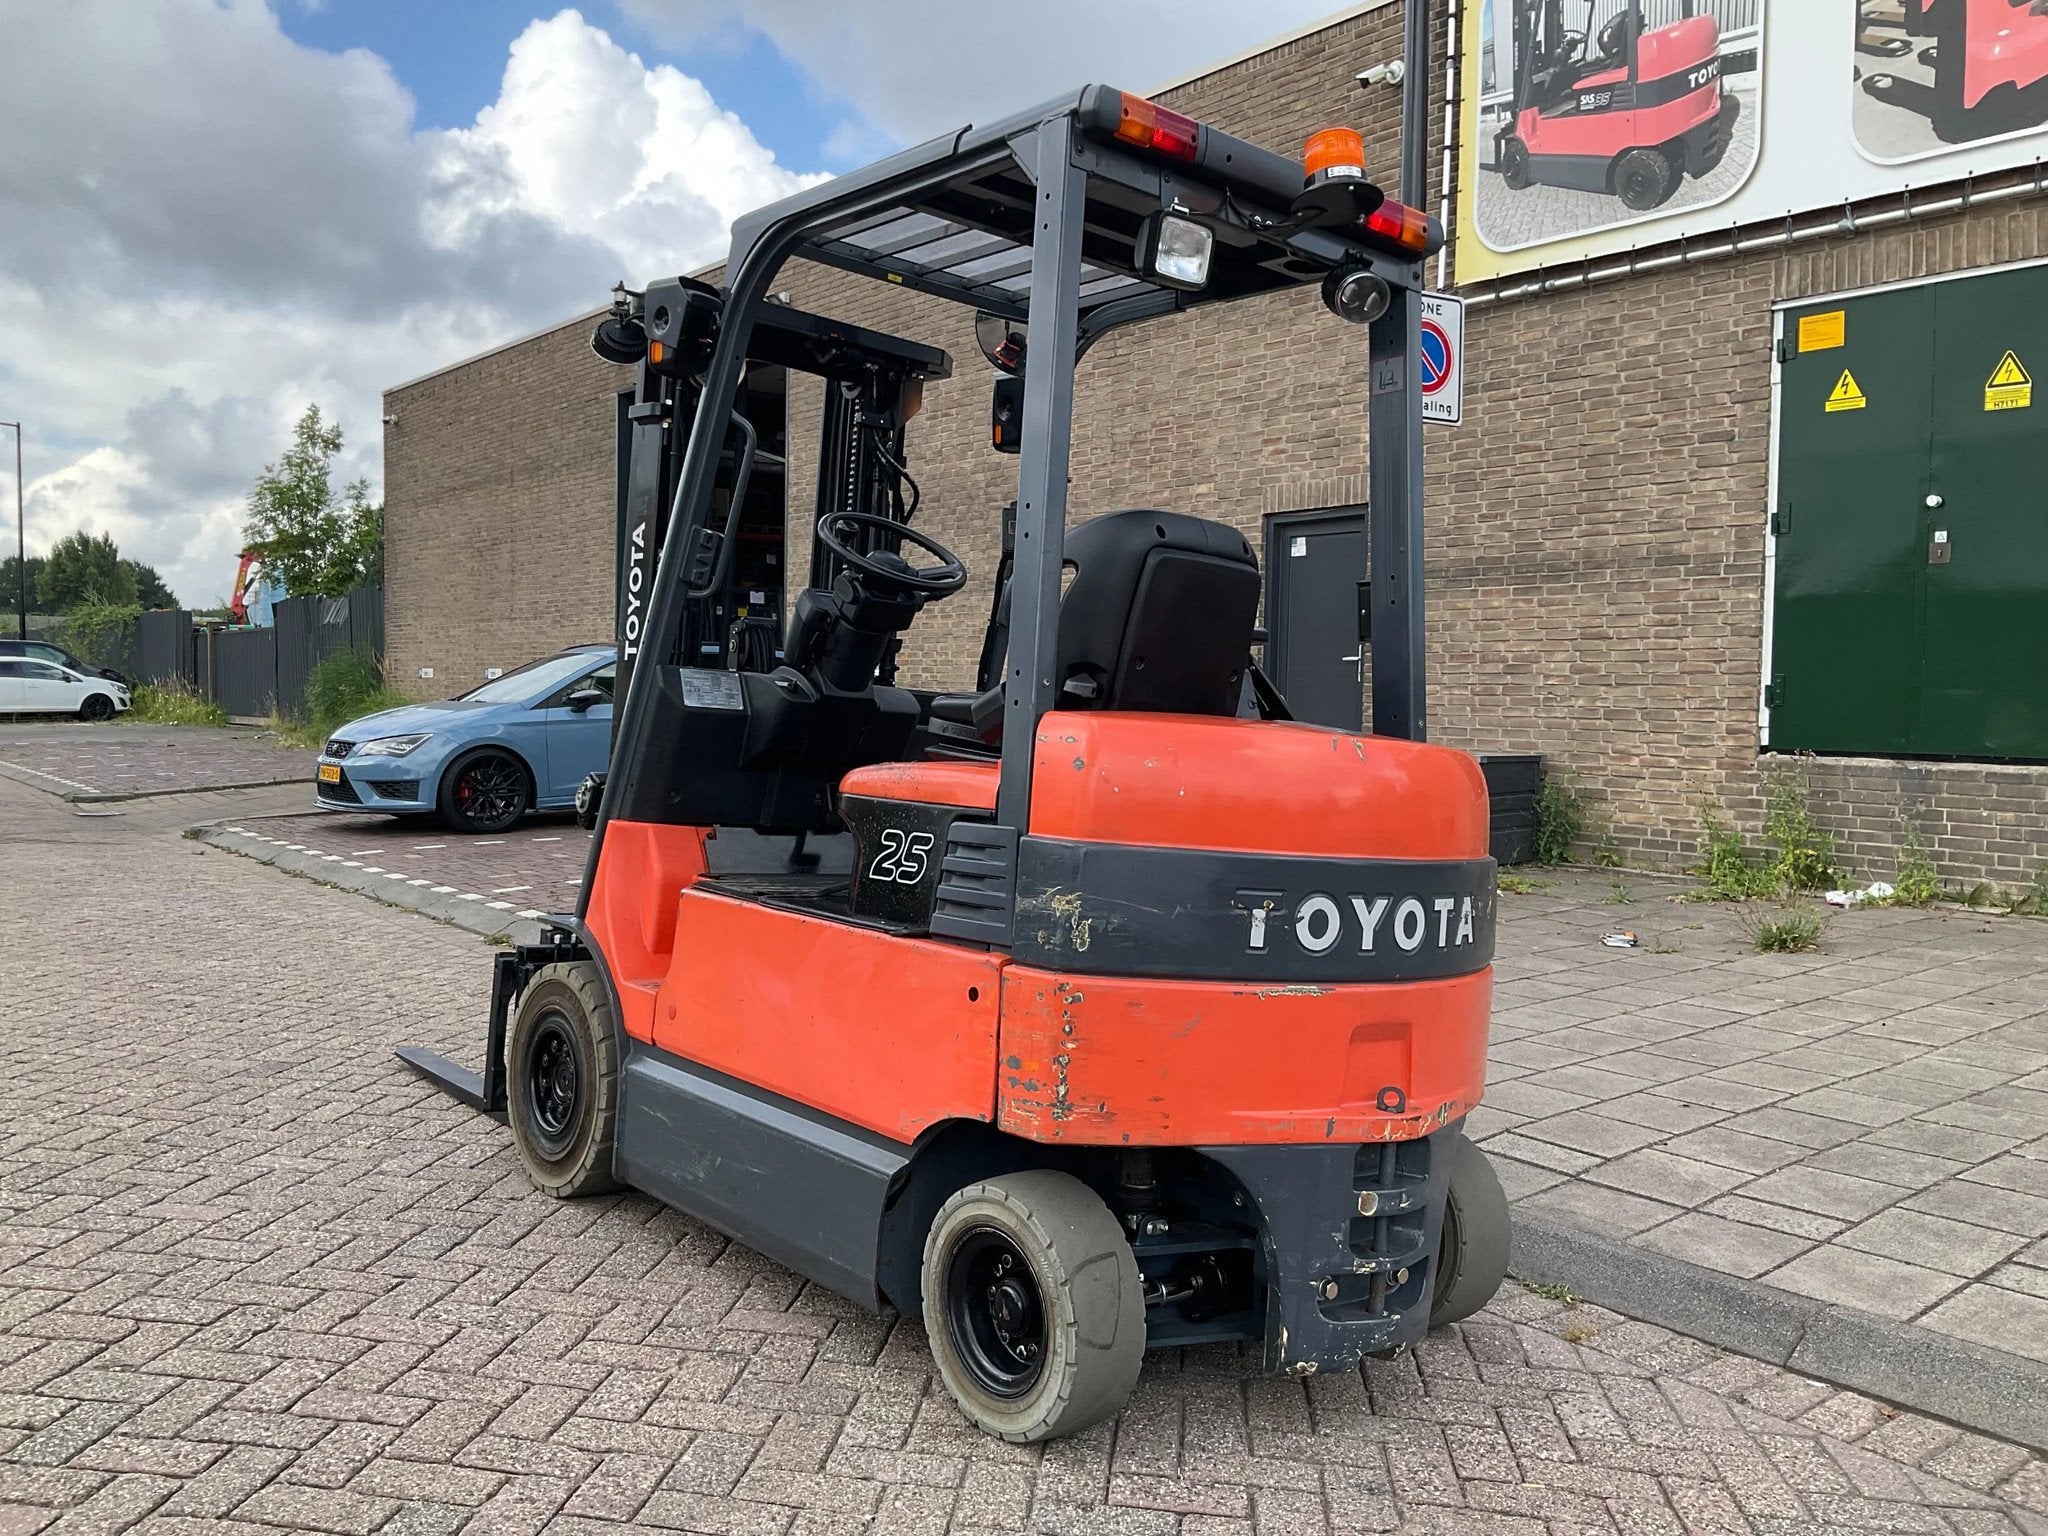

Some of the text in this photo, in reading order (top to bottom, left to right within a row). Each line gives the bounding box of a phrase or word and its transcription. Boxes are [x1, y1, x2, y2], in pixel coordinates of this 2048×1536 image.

[1580, 94, 1595, 105] SAS
[1421, 302, 1442, 316] ONE
[1423, 400, 1452, 416] aling
[624, 521, 646, 661] TOYOTA
[869, 828, 935, 885] 25
[1236, 889, 1475, 952] TOYOTA
